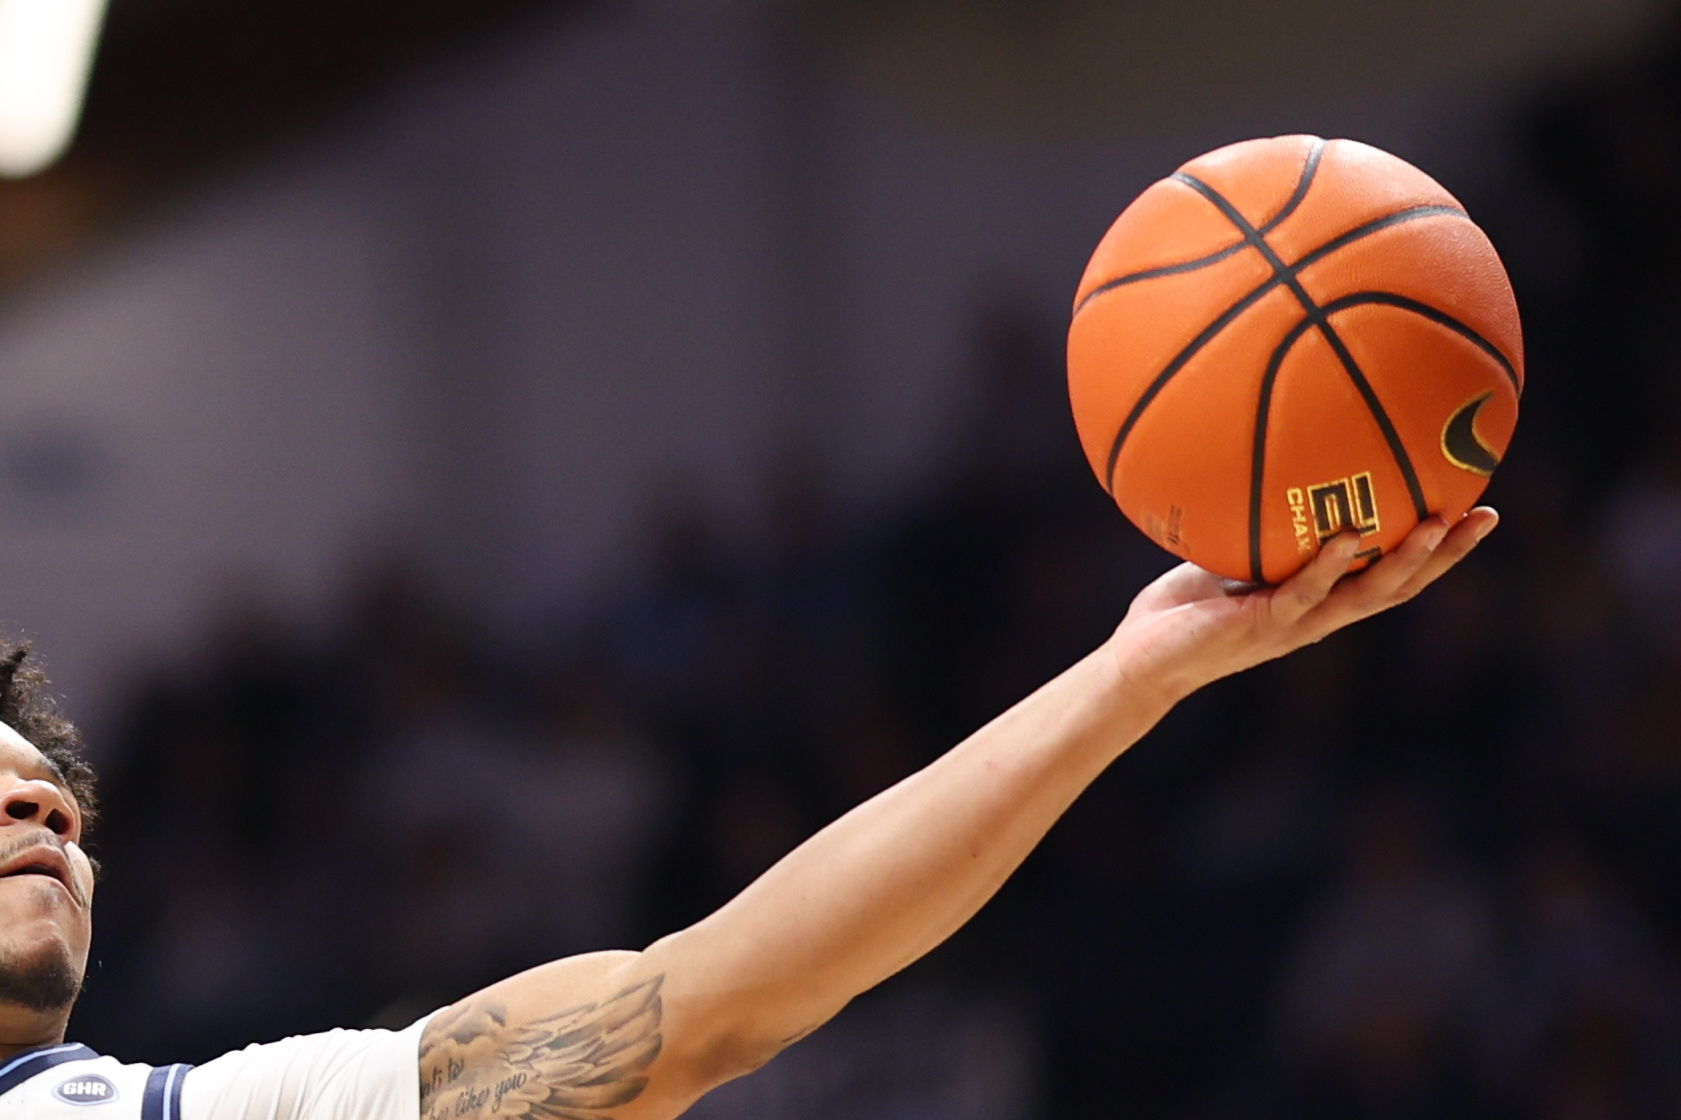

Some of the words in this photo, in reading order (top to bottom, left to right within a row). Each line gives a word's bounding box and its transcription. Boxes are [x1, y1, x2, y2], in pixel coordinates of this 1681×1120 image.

[62, 1081, 108, 1097] GHR
[455, 1087, 490, 1118] like
[492, 1072, 528, 1114] you
